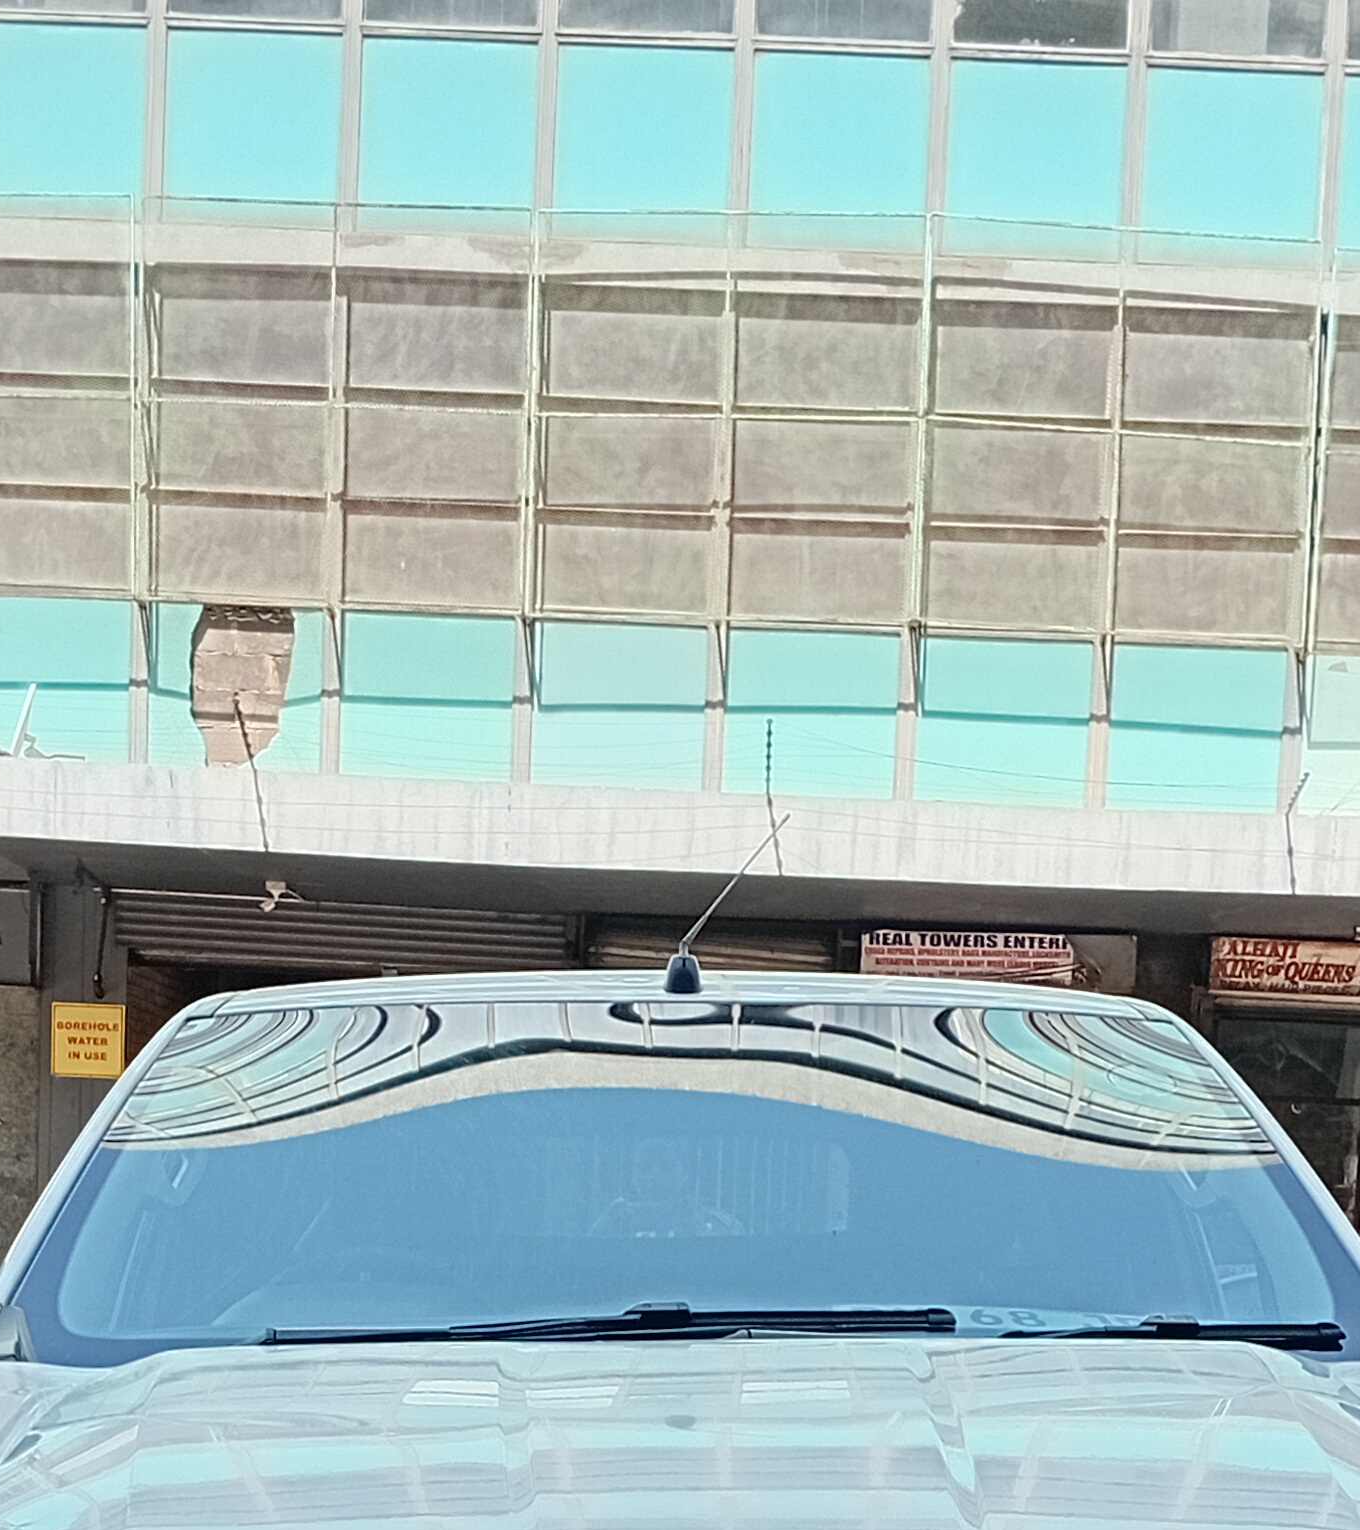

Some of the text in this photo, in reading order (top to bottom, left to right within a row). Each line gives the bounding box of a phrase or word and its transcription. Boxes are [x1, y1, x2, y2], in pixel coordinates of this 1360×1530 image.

[868, 932, 913, 946] REAL
[918, 933, 998, 948] TOWERS
[1213, 958, 1357, 984] KING OF QUEENS
[56, 1021, 120, 1032] BOREHOLE
[67, 1036, 108, 1046] WATER
[68, 1050, 107, 1061] IN USE
